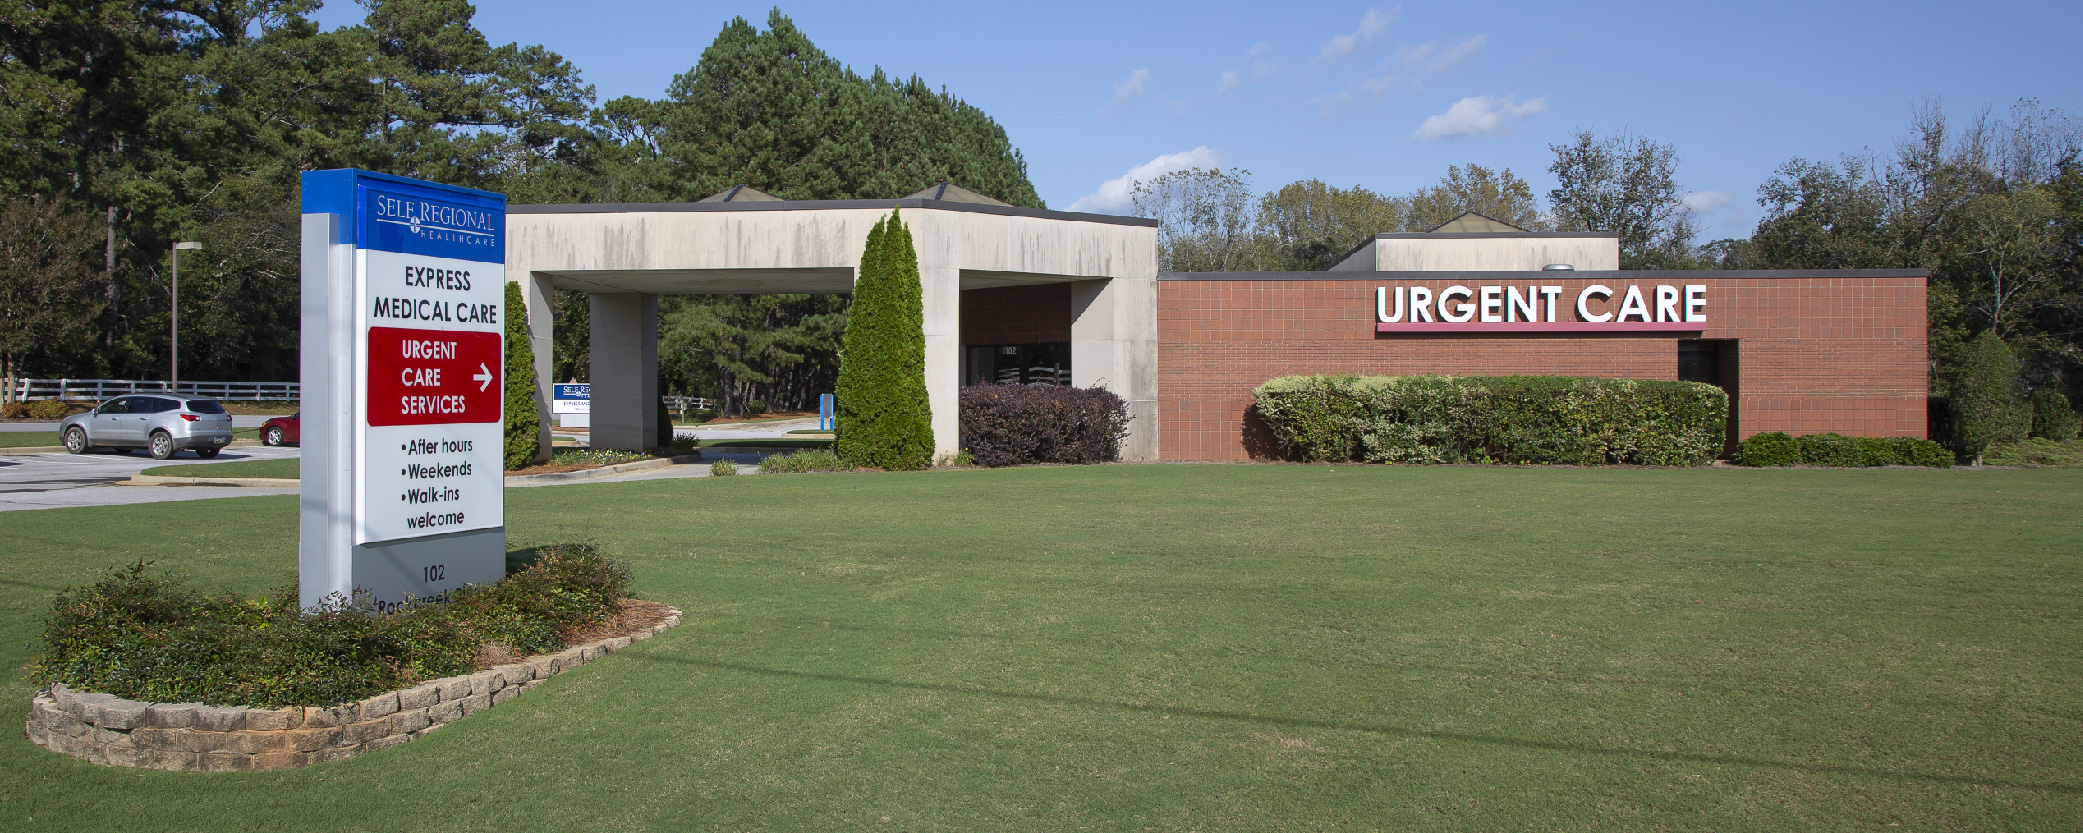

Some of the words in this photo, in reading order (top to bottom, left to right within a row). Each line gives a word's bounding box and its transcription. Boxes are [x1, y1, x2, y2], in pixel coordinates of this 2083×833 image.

[377, 194, 415, 219] SELF
[420, 201, 495, 231] REGIONAL
[420, 230, 495, 247] HEALTHCARE
[405, 265, 471, 291] EXPRESS
[373, 296, 451, 323] MEDICAL
[456, 302, 497, 324] CARE
[1377, 285, 1562, 323] URGENT
[1577, 284, 1707, 323] CARE
[402, 339, 457, 360] URGENT
[401, 367, 441, 387] CARE
[401, 395, 466, 415] SERVICES
[408, 439, 438, 456] After
[442, 437, 473, 453] hours
[408, 460, 472, 479] Weekends
[408, 486, 460, 504] Walk-ins
[407, 511, 465, 529] welcome
[423, 564, 445, 583] 102
